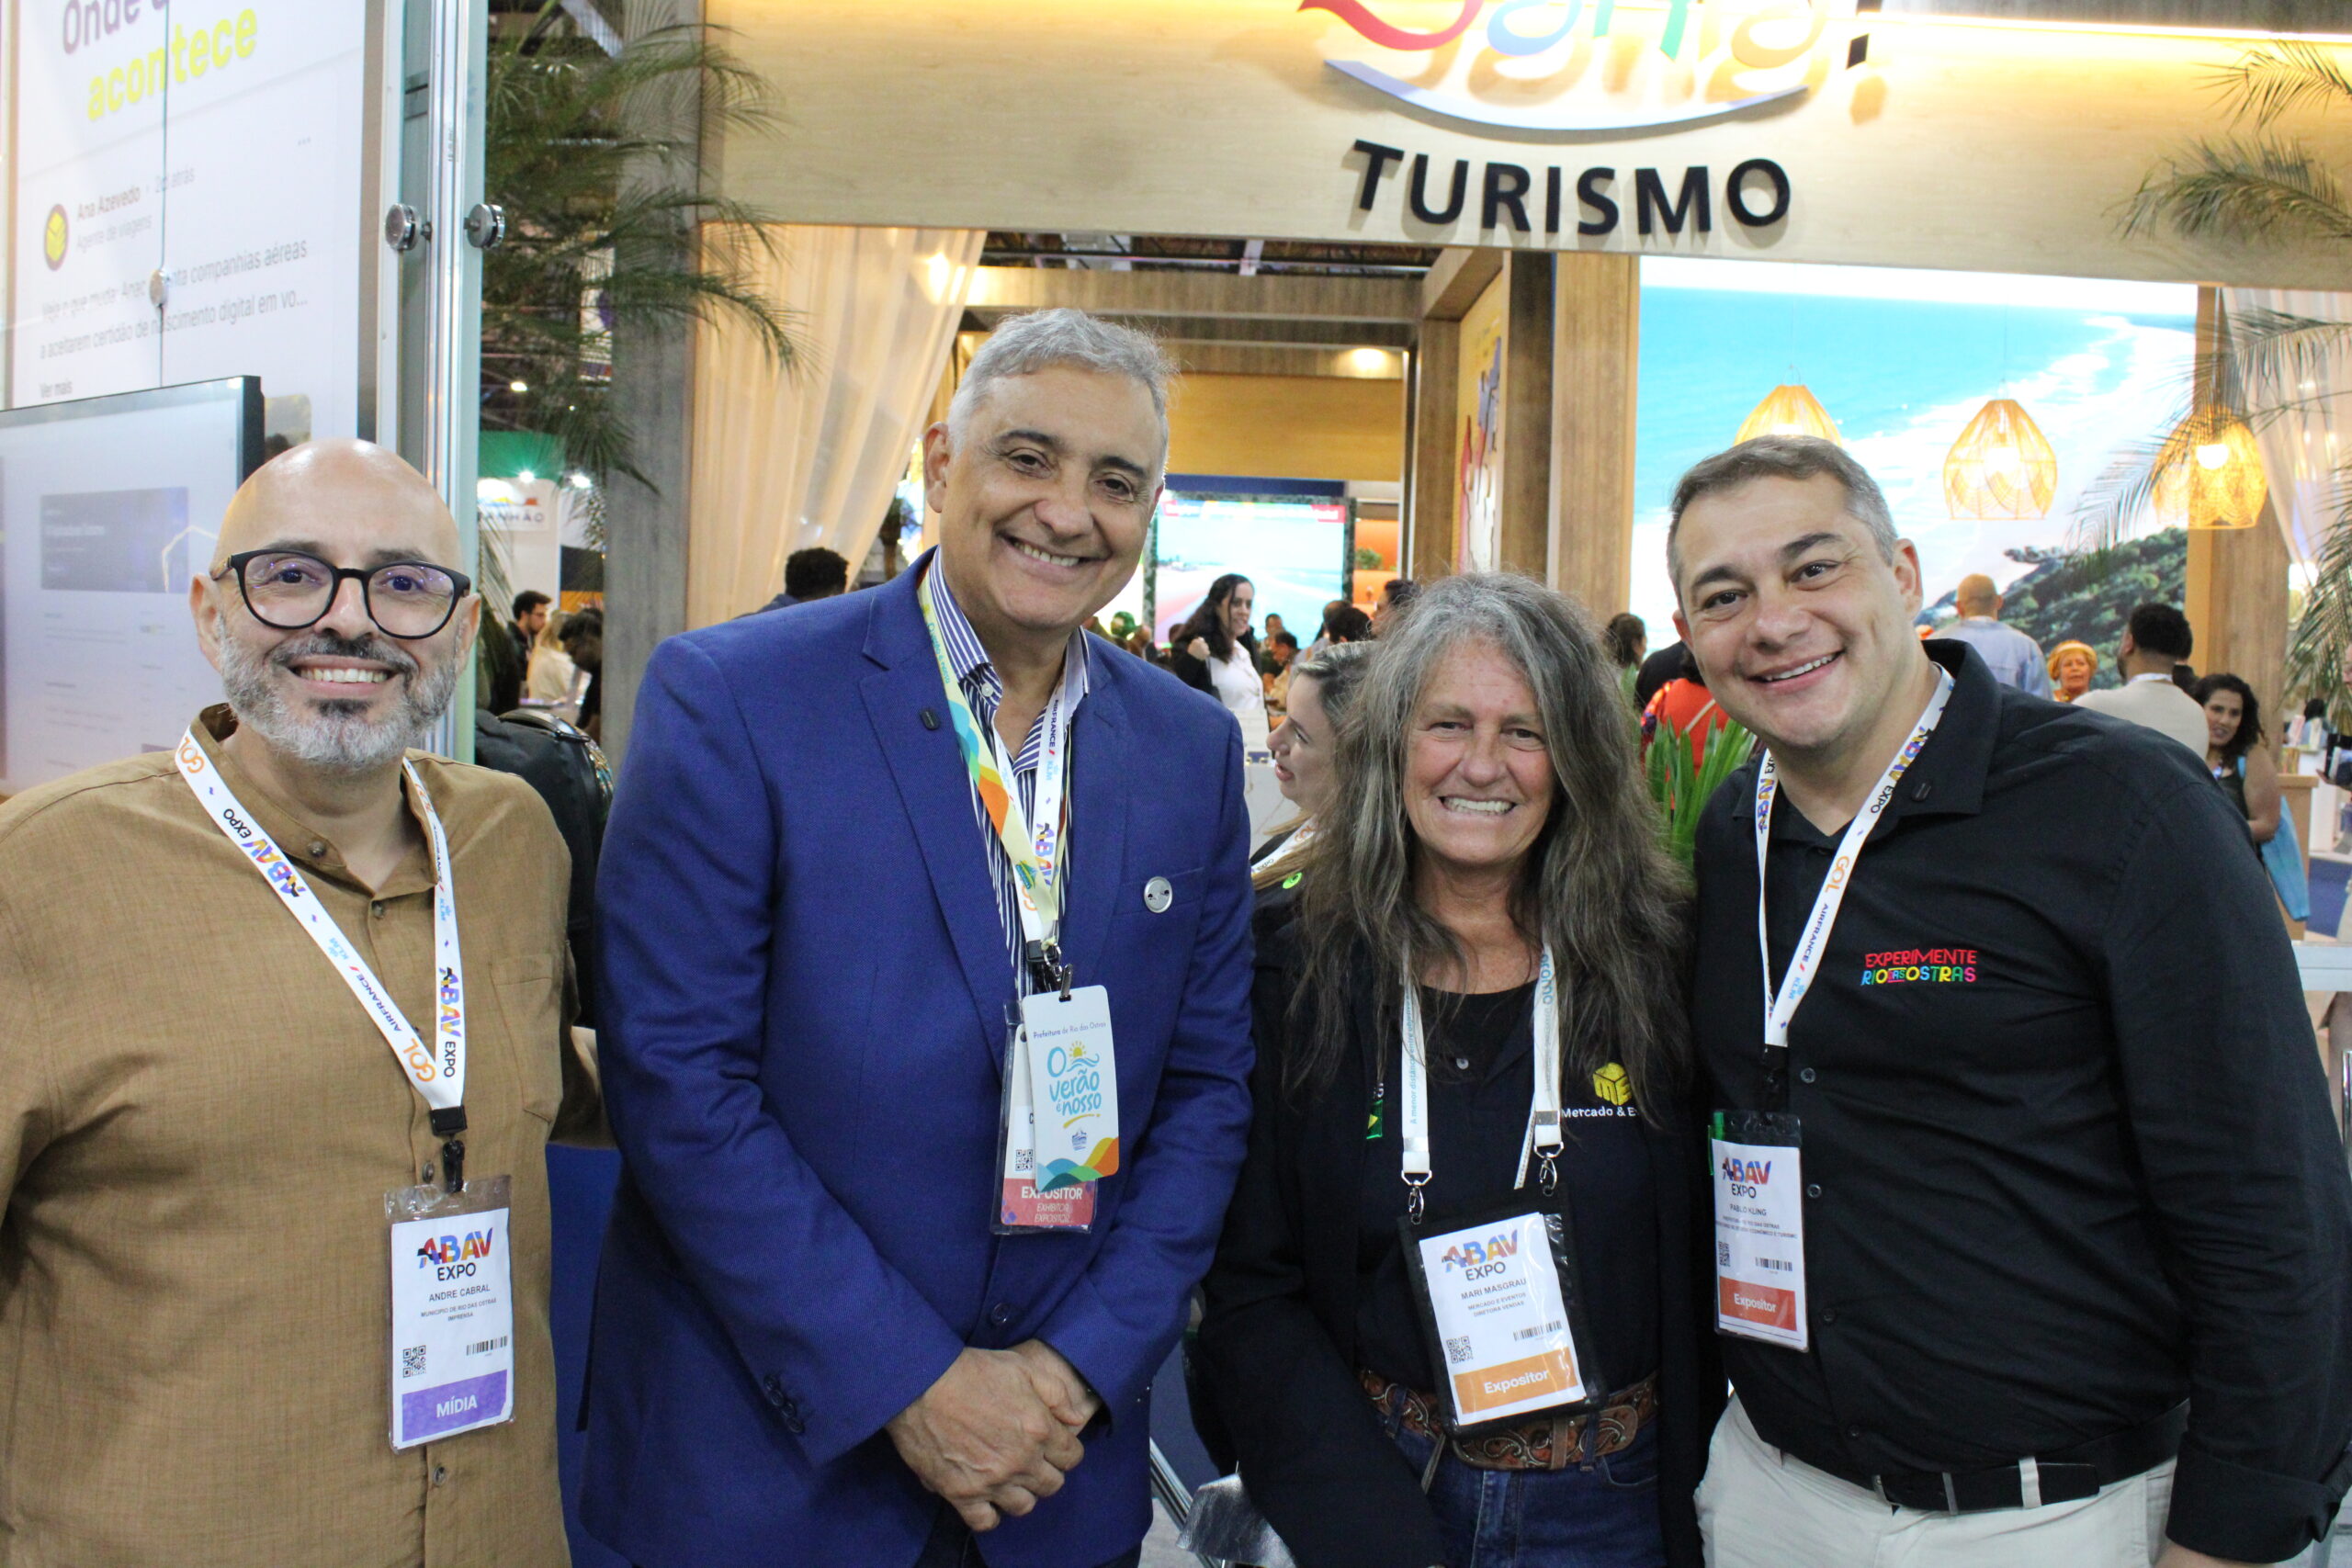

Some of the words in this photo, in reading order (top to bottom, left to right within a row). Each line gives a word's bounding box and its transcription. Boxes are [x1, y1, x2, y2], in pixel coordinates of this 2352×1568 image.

[63, 0, 141, 54] Onde
[87, 8, 258, 121] acontece
[77, 199, 96, 221] Ana
[97, 185, 141, 216] Azevedo
[169, 166, 196, 189] atrás
[1352, 139, 1792, 236] TURISMO
[75, 228, 105, 254] Agente
[107, 224, 118, 242] de
[119, 214, 153, 242] viagens
[190, 249, 262, 286] companhias
[264, 239, 309, 266] aéreas
[48, 332, 92, 358] aceitarem
[93, 318, 134, 349] certidão
[135, 319, 150, 339] de
[151, 305, 217, 335] nascimento
[219, 296, 256, 327] digital
[258, 292, 277, 312] em
[40, 381, 53, 399] Ver
[54, 378, 74, 395] mais
[1049, 699, 1059, 748] AIRFRANCE
[178, 738, 205, 774] GOL
[1764, 756, 1776, 774] EXP
[1756, 778, 1776, 835] ABAV
[1870, 784, 1895, 814] EXPO
[221, 807, 253, 840] EXPO
[241, 837, 308, 898] ABAV
[1825, 855, 1850, 894] GOL
[1804, 903, 1829, 964] AIRFRANCE
[1865, 948, 1978, 968] EXPERIMENTE
[1905, 965, 1977, 983] OSTRAS
[356, 973, 403, 1032] AIRFRANCE
[438, 966, 464, 1038] ABAV
[1034, 1028, 1061, 1040] Prefeitura
[402, 1038, 436, 1083] GOL
[444, 1041, 456, 1078] EXPO
[1046, 1045, 1067, 1077] O
[1408, 1055, 1418, 1090] distância
[1049, 1067, 1101, 1102] verão
[1056, 1100, 1062, 1112] é
[1062, 1092, 1102, 1116] nosso
[1561, 1106, 1613, 1118] Mercado
[1617, 1106, 1626, 1117] &
[1722, 1156, 1772, 1186] ABAV
[1731, 1183, 1757, 1200] EXPO
[1730, 1203, 1747, 1213] PABLO
[1747, 1207, 1767, 1217] KLING
[417, 1227, 493, 1269] ABAV
[1441, 1228, 1519, 1273] ABAV
[437, 1262, 476, 1282] EXPO
[1465, 1261, 1507, 1282] EXPO
[428, 1289, 458, 1303] ANDRE
[459, 1283, 491, 1298] CABRAL
[1460, 1288, 1483, 1301] MARI
[1484, 1278, 1528, 1295] MASGRAU
[1467, 1299, 1496, 1311] MERCADO
[1499, 1292, 1527, 1303] EVENTOS
[1734, 1292, 1778, 1314] Expositor
[1473, 1305, 1502, 1318] DIRETORA
[1501, 1300, 1525, 1311] VENDAS
[1483, 1367, 1551, 1396] Expositor
[436, 1393, 478, 1419] MÍDIA
